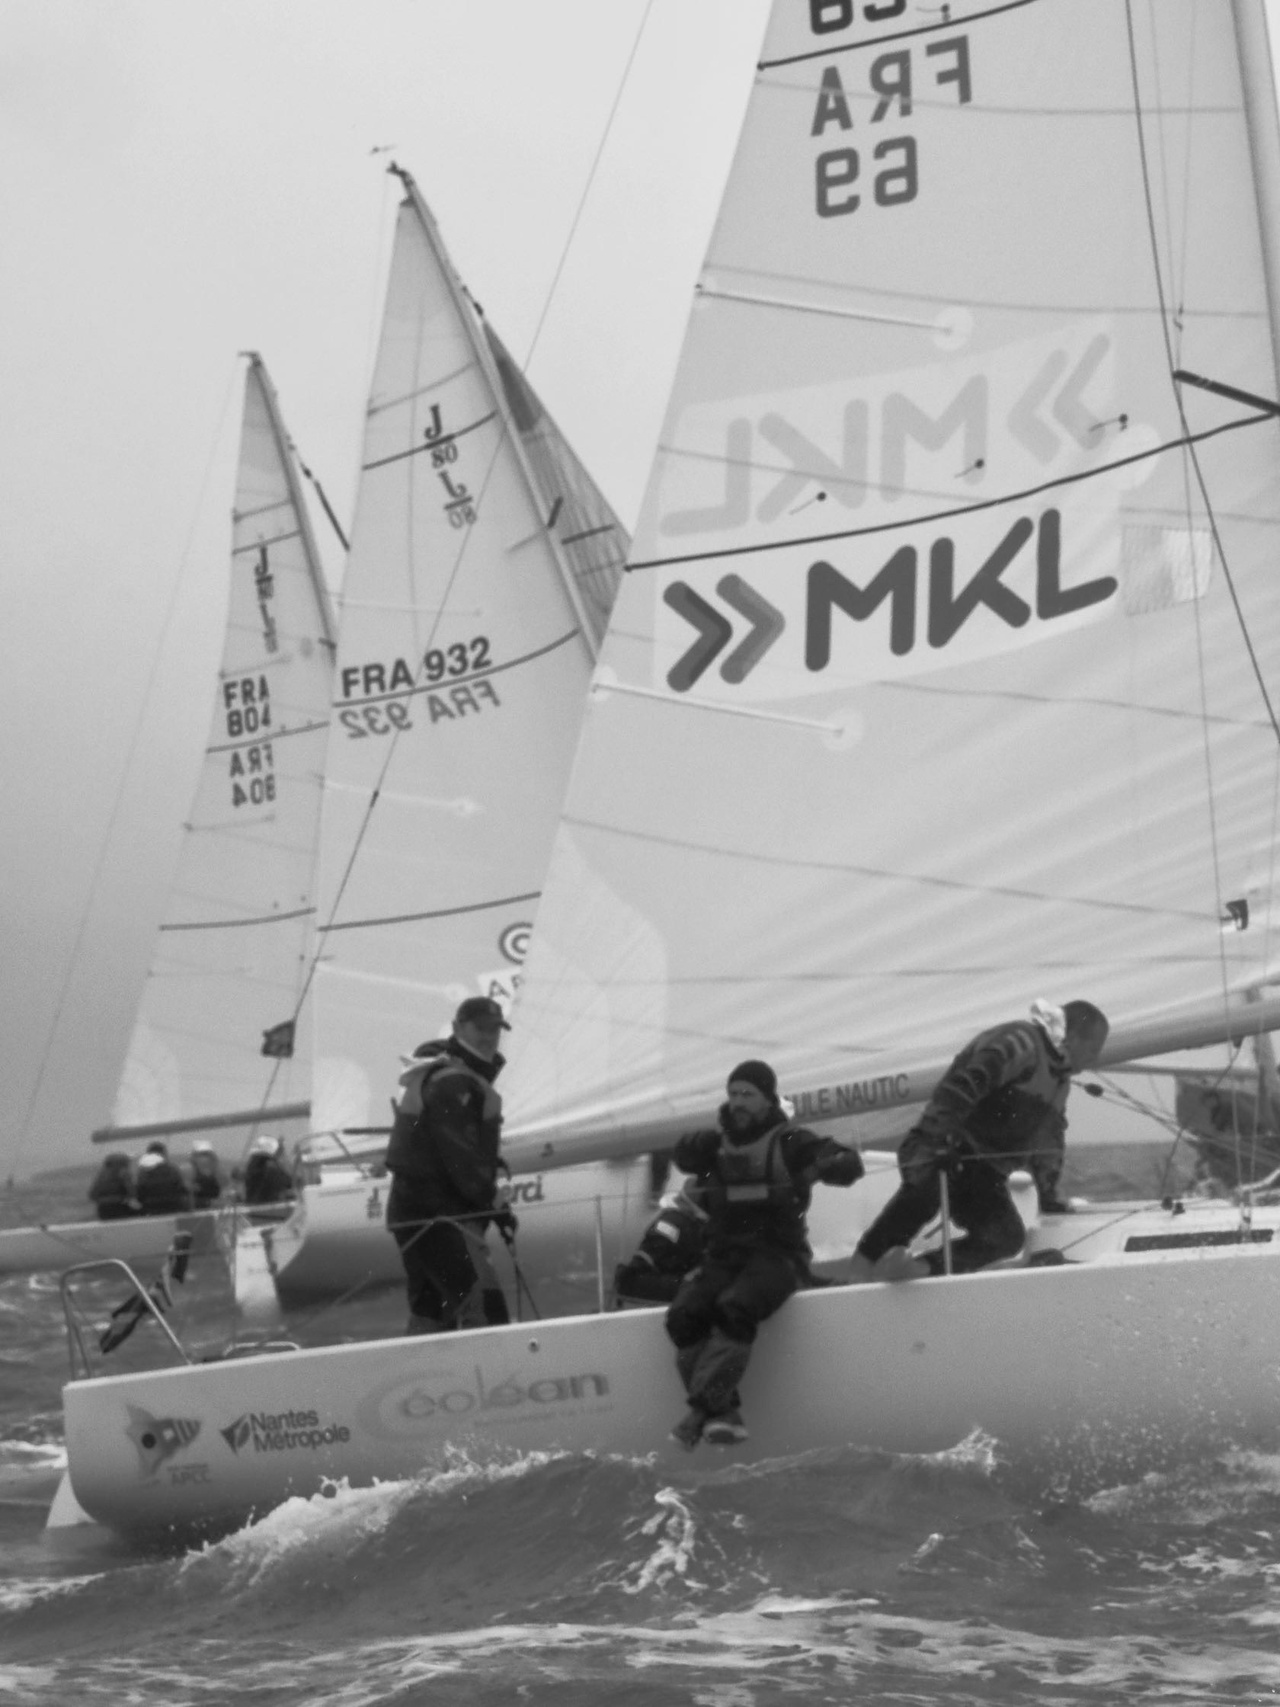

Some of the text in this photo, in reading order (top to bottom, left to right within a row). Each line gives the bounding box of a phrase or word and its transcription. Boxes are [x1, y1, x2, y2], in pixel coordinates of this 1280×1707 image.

[423, 403, 441, 440] J
[804, 507, 1119, 673] MKL
[341, 634, 493, 698] FRA 932
[835, 1072, 911, 1110] NAUTIC
[249, 1409, 320, 1432] Nantes
[252, 1422, 351, 1453] Métropole
